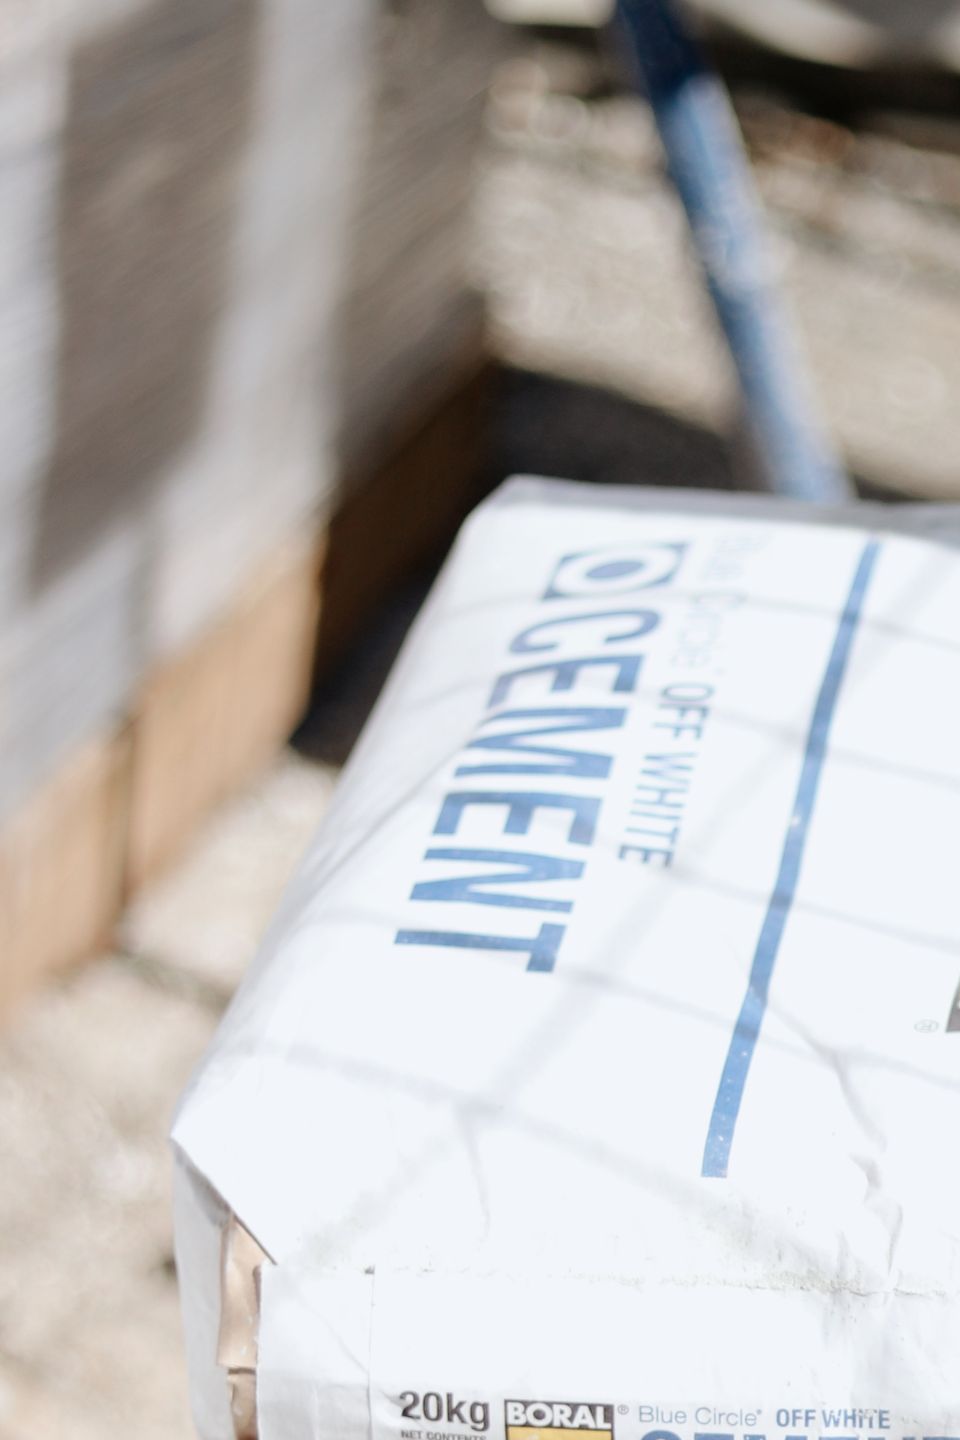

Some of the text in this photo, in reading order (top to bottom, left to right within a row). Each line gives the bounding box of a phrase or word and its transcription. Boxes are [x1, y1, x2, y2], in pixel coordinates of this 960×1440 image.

[652, 682, 715, 742] OFF
[394, 608, 662, 975] CEMENT
[617, 751, 699, 868] WHITE
[399, 1391, 490, 1432] 20kg
[507, 1402, 613, 1430] BORAL
[638, 1405, 891, 1429] Blue Circle OFF WHITE
[400, 1429, 423, 1440] NET
